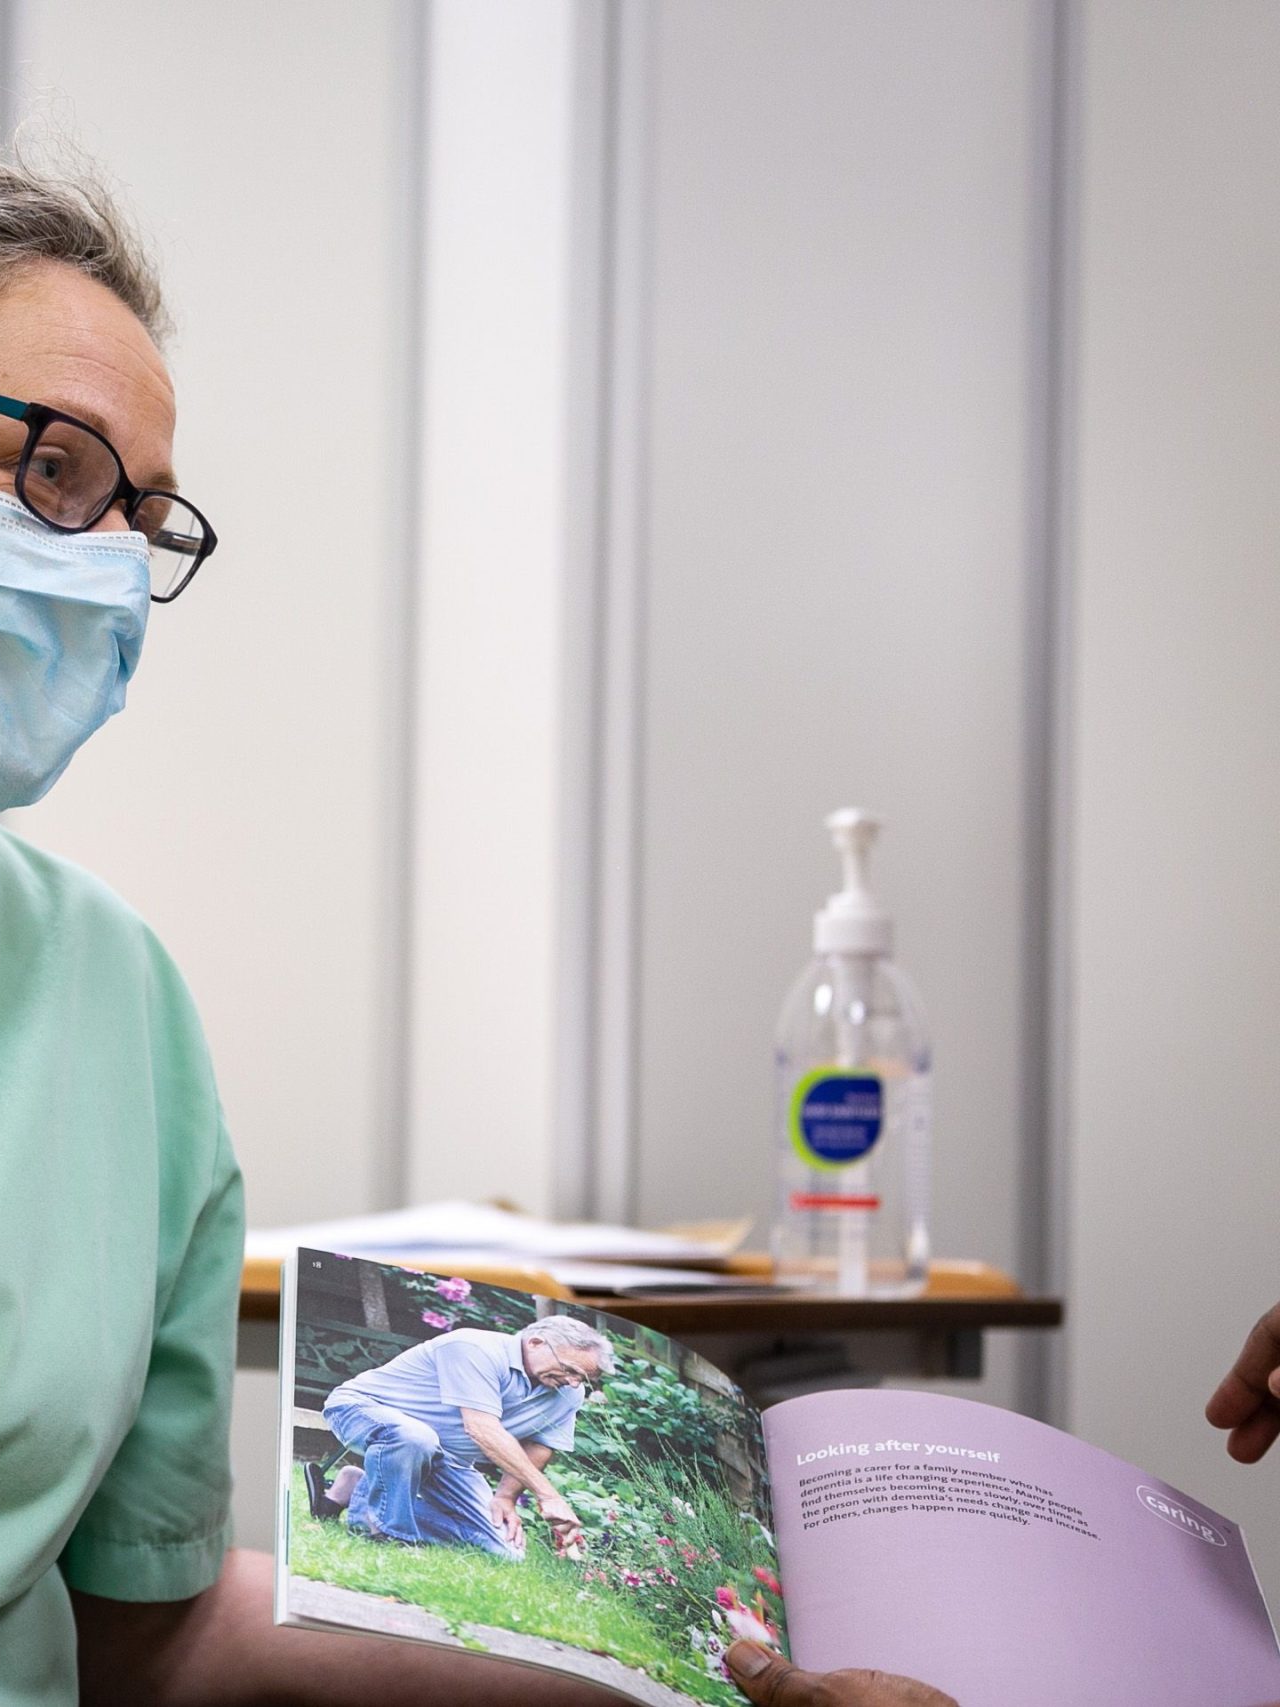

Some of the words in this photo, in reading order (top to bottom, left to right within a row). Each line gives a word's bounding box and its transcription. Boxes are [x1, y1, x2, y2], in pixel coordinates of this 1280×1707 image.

[797, 1443, 870, 1466] Looking
[874, 1439, 921, 1452] after
[924, 1443, 1001, 1463] yourself
[799, 1468, 852, 1487] Becoming
[923, 1464, 958, 1475] family
[961, 1469, 1007, 1482] member
[1009, 1479, 1033, 1490] who
[1035, 1485, 1053, 1497] has
[800, 1479, 851, 1498] dementia
[896, 1473, 948, 1483] changing
[950, 1477, 1014, 1493] experience.
[1015, 1489, 1045, 1503] Many
[1048, 1500, 1083, 1516] people
[801, 1496, 821, 1508] find
[824, 1485, 887, 1501] themselves
[890, 1483, 946, 1493] becoming
[948, 1486, 981, 1496] carers
[983, 1491, 1021, 1505] slowly,
[1023, 1501, 1046, 1511] over
[1048, 1508, 1076, 1523] time,
[1077, 1519, 1088, 1527] as
[802, 1509, 820, 1519] the
[823, 1500, 859, 1514] person
[862, 1495, 888, 1504] with
[891, 1493, 953, 1502] dementia's
[956, 1497, 989, 1506] needs
[991, 1502, 1031, 1516] change
[1033, 1512, 1053, 1523] and
[1055, 1518, 1101, 1541] increase.
[803, 1520, 820, 1530] For
[822, 1511, 860, 1524] others,
[862, 1504, 909, 1513] changes
[911, 1503, 955, 1512] happen
[957, 1507, 987, 1516] more
[989, 1511, 1031, 1526] quickly.
[1146, 1495, 1216, 1543] caring
